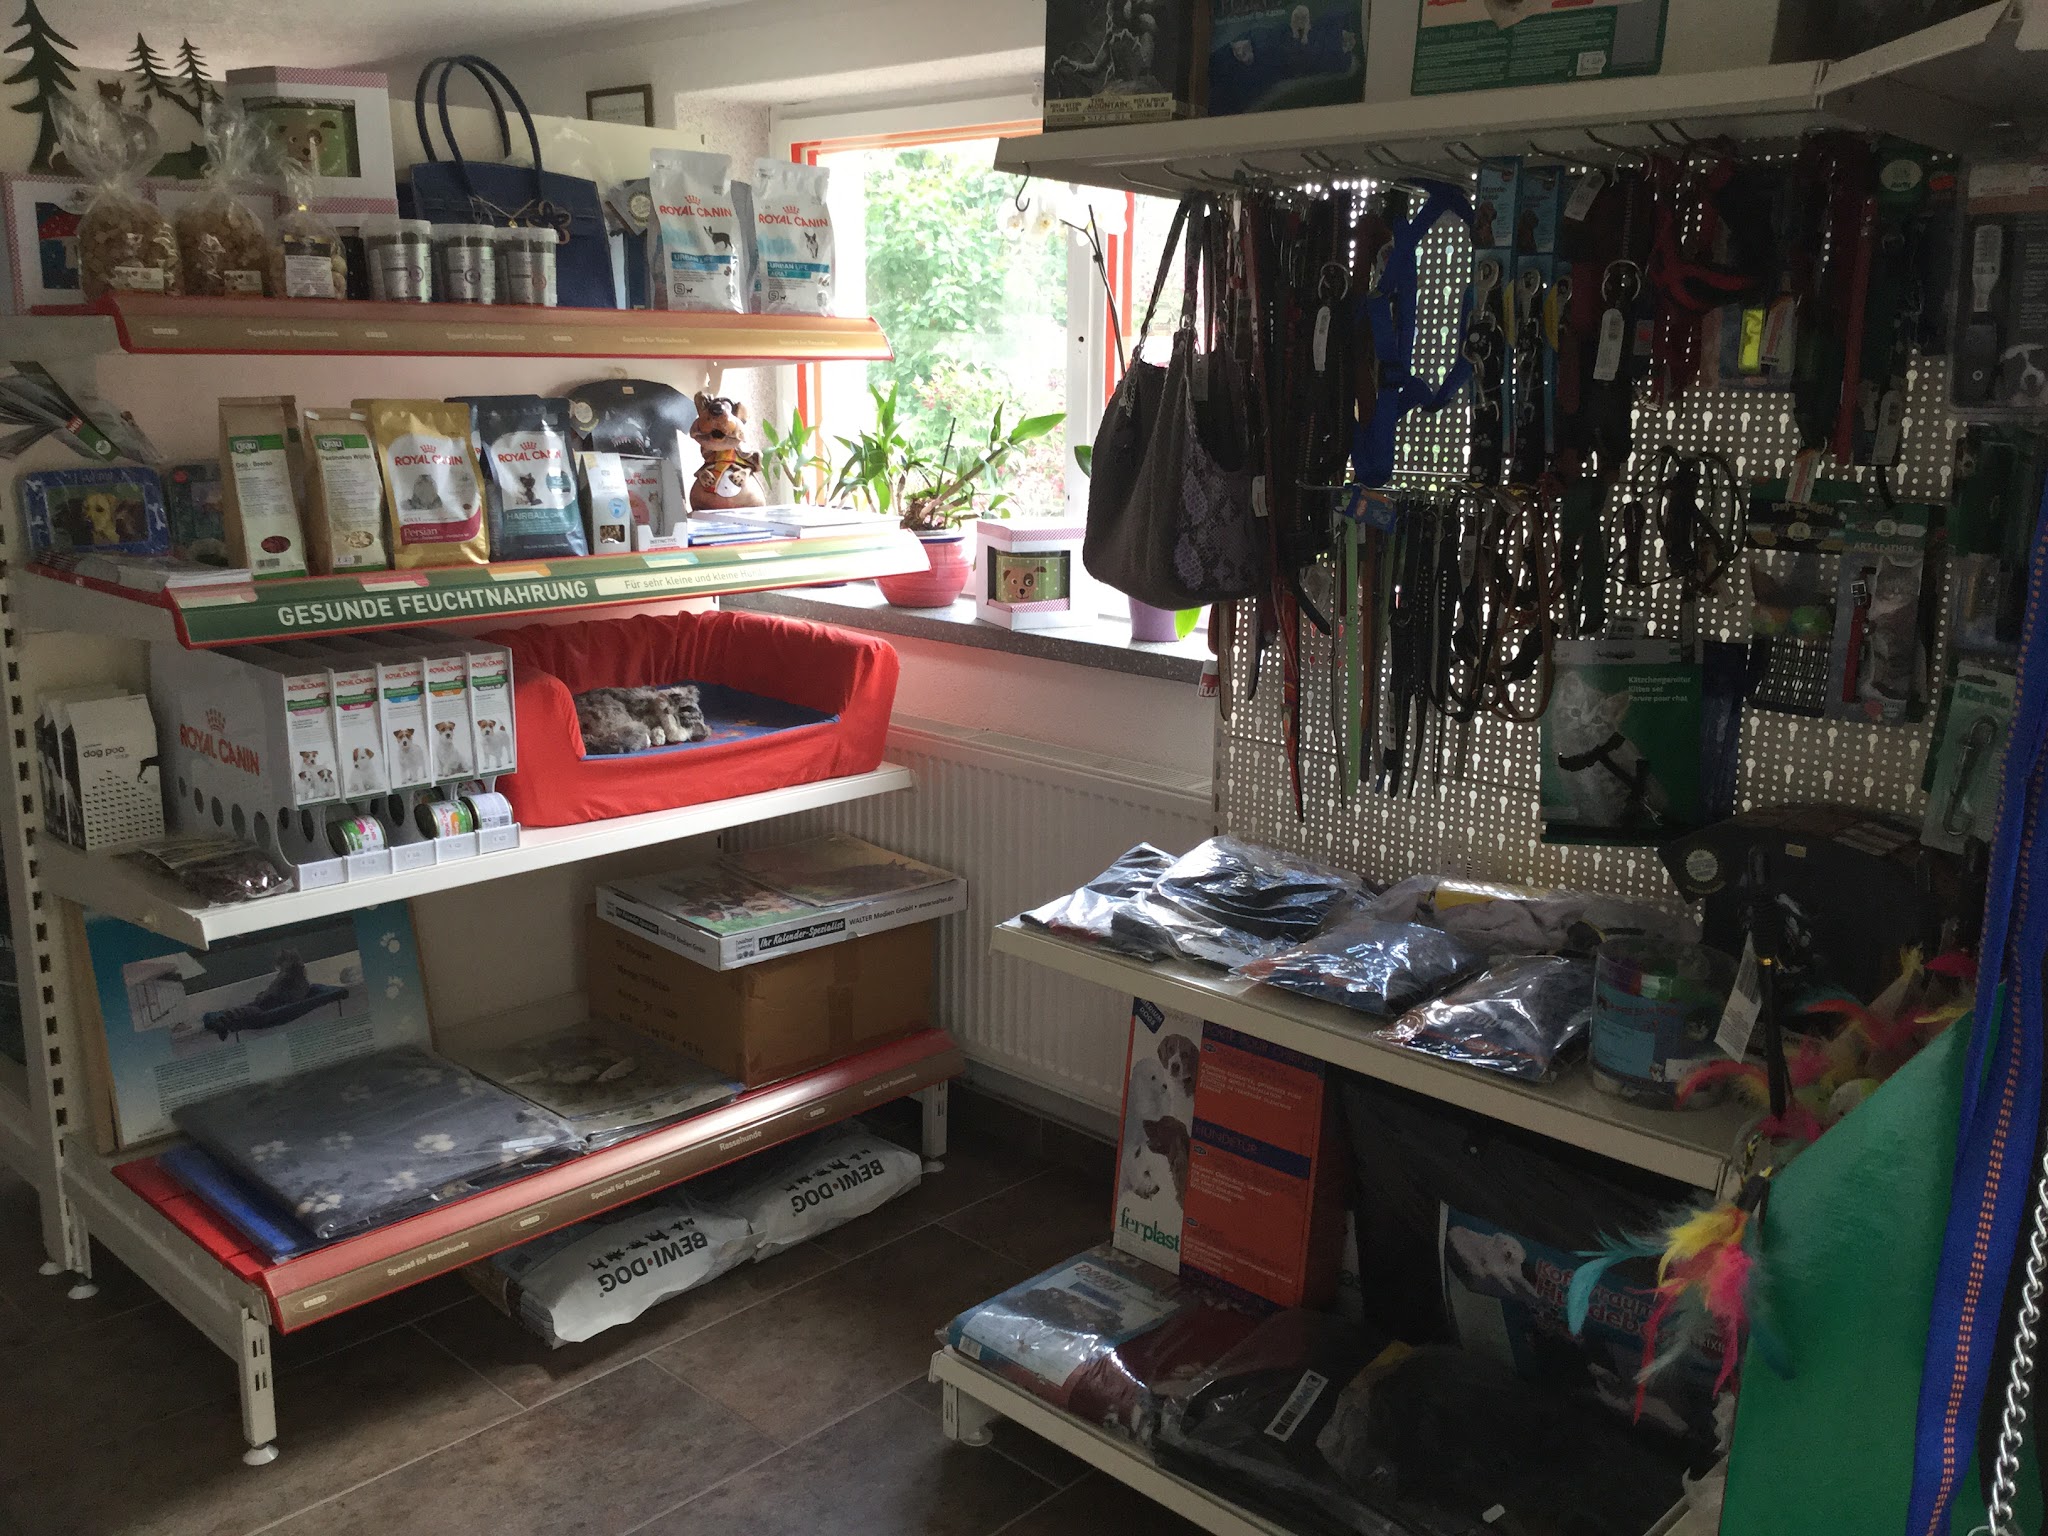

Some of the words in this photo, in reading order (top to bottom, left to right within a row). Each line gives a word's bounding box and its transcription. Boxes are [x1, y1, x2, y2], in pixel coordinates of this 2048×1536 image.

[659, 205, 695, 217] ROYAL
[697, 206, 732, 218] CANIN
[758, 213, 792, 225] ROYAL
[794, 216, 828, 228] CANIN
[236, 441, 256, 452] grau
[322, 440, 342, 450] grau
[394, 454, 430, 466] ROYAL
[432, 456, 464, 466] CIN
[498, 451, 531, 462] ROYAL
[532, 450, 562, 461] CAN
[639, 478, 658, 486] CANIN
[506, 512, 549, 520] HAIRBALL
[404, 526, 438, 536] Persian
[624, 578, 641, 590] Für
[643, 576, 664, 588] sehr
[666, 574, 694, 586] kleine
[696, 573, 712, 583] und
[713, 571, 739, 581] kleine
[278, 598, 394, 627] GESUNDE
[400, 581, 588, 615] FEUCHTNAHRUNG
[83, 748, 104, 758] dog
[105, 746, 124, 757] poo
[179, 723, 218, 759] ROYAL
[218, 738, 260, 776] CANIN
[759, 934, 772, 950] Ihr
[772, 918, 846, 946] Kalender-Spezialist
[849, 914, 872, 926] WALTER
[874, 910, 895, 920] Medien
[896, 904, 914, 914] GmbH
[1144, 1000, 1164, 1023] EDIUM
[719, 1130, 762, 1151] Rassehunde
[590, 1184, 616, 1200] Speziell
[616, 1182, 625, 1192] für
[626, 1169, 661, 1188] Rassehunde
[1120, 1206, 1181, 1252] ferplast
[386, 1259, 416, 1277] Speziell
[416, 1256, 427, 1267] für
[428, 1241, 470, 1262] Rassehunde
